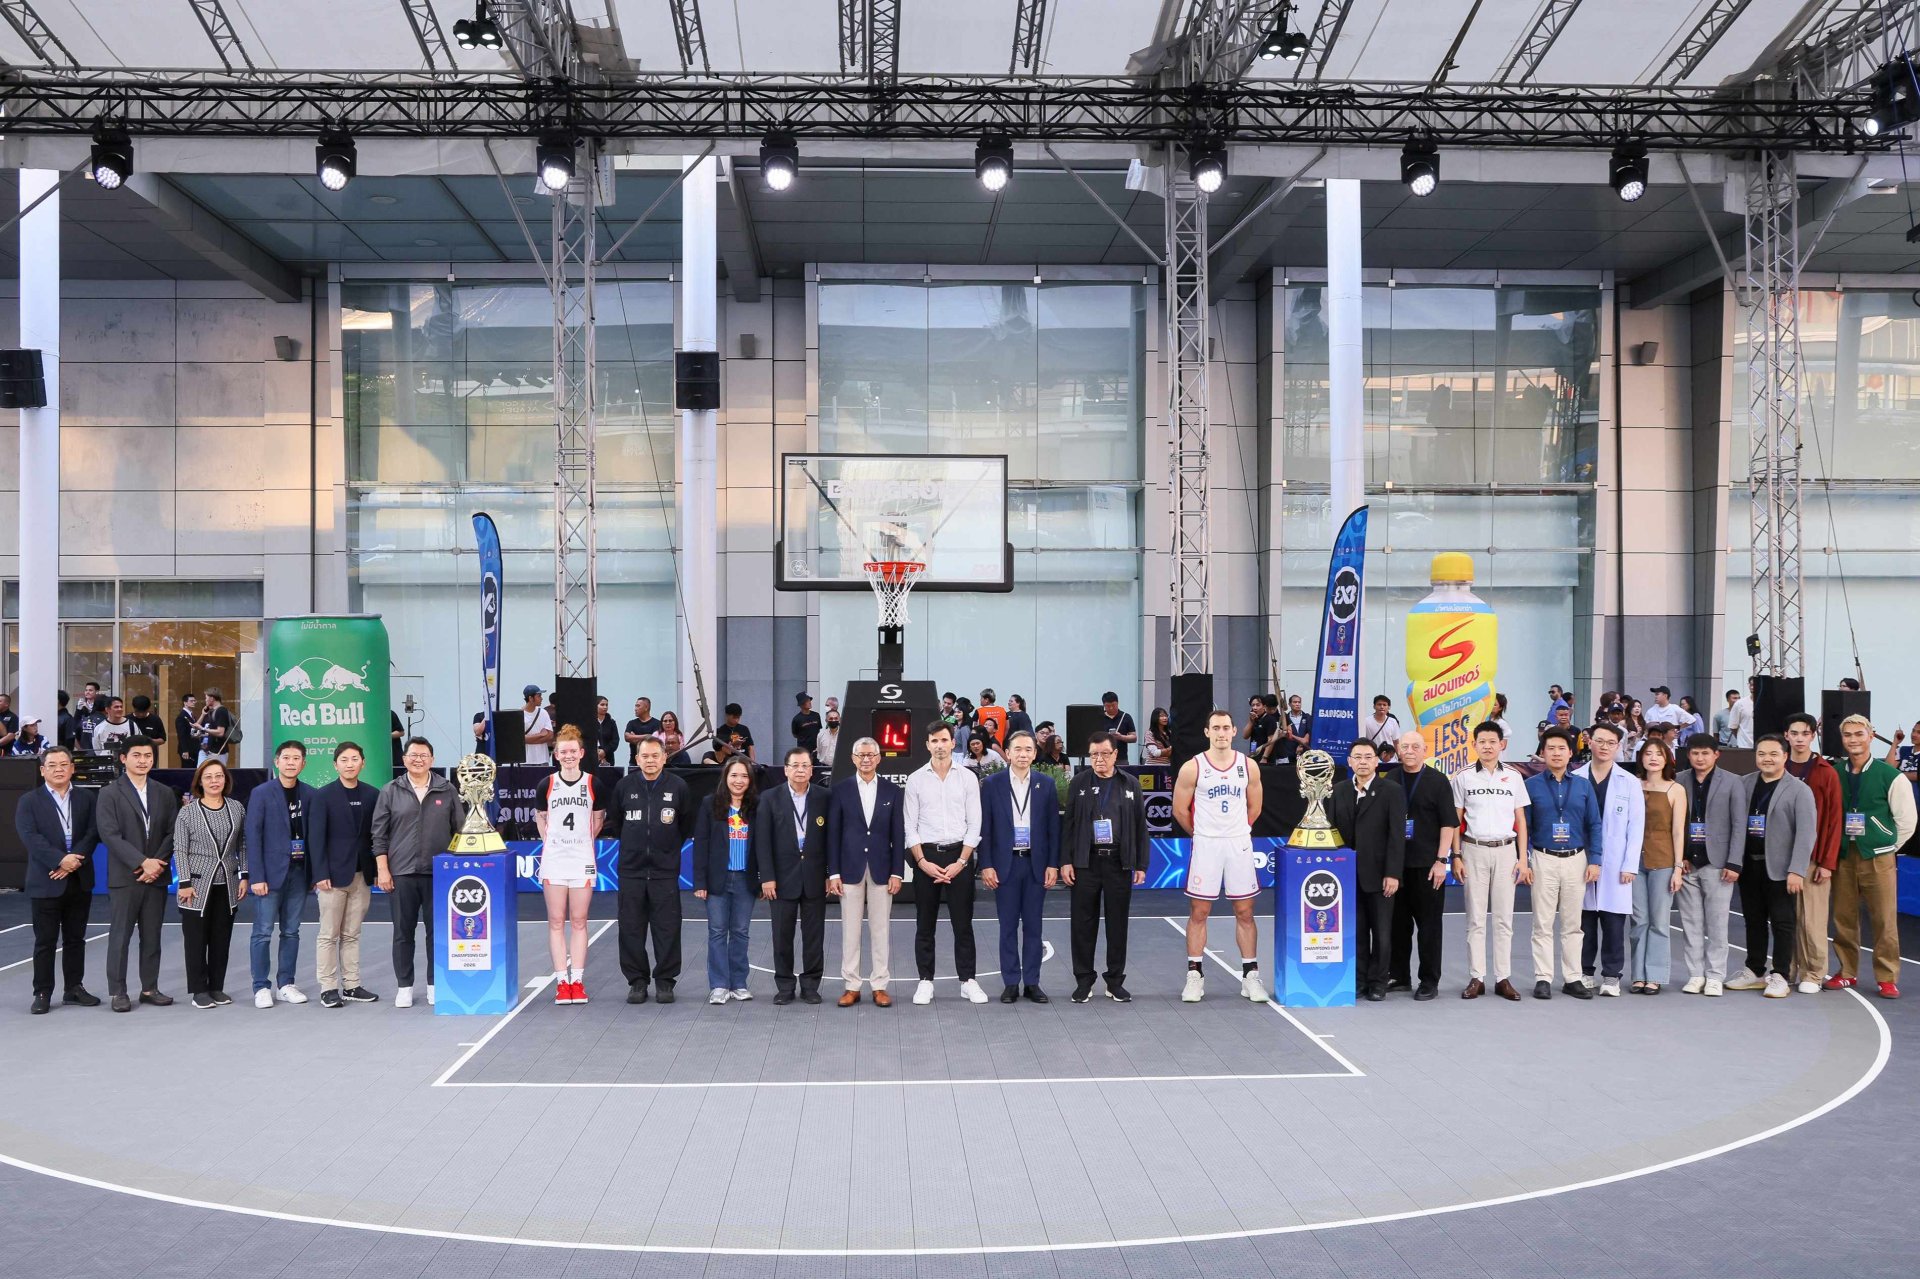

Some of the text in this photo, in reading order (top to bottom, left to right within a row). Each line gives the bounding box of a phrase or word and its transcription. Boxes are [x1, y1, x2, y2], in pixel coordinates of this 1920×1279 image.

[1423, 664, 1480, 702] สปอนเซอร์
[279, 702, 365, 726] Red Bull
[1434, 714, 1470, 757] LESS
[1434, 746, 1469, 776] SUGAR
[552, 797, 588, 809] CANADA
[1467, 788, 1514, 797] HONDA
[1221, 800, 1229, 813] 6
[562, 812, 575, 831] 4
